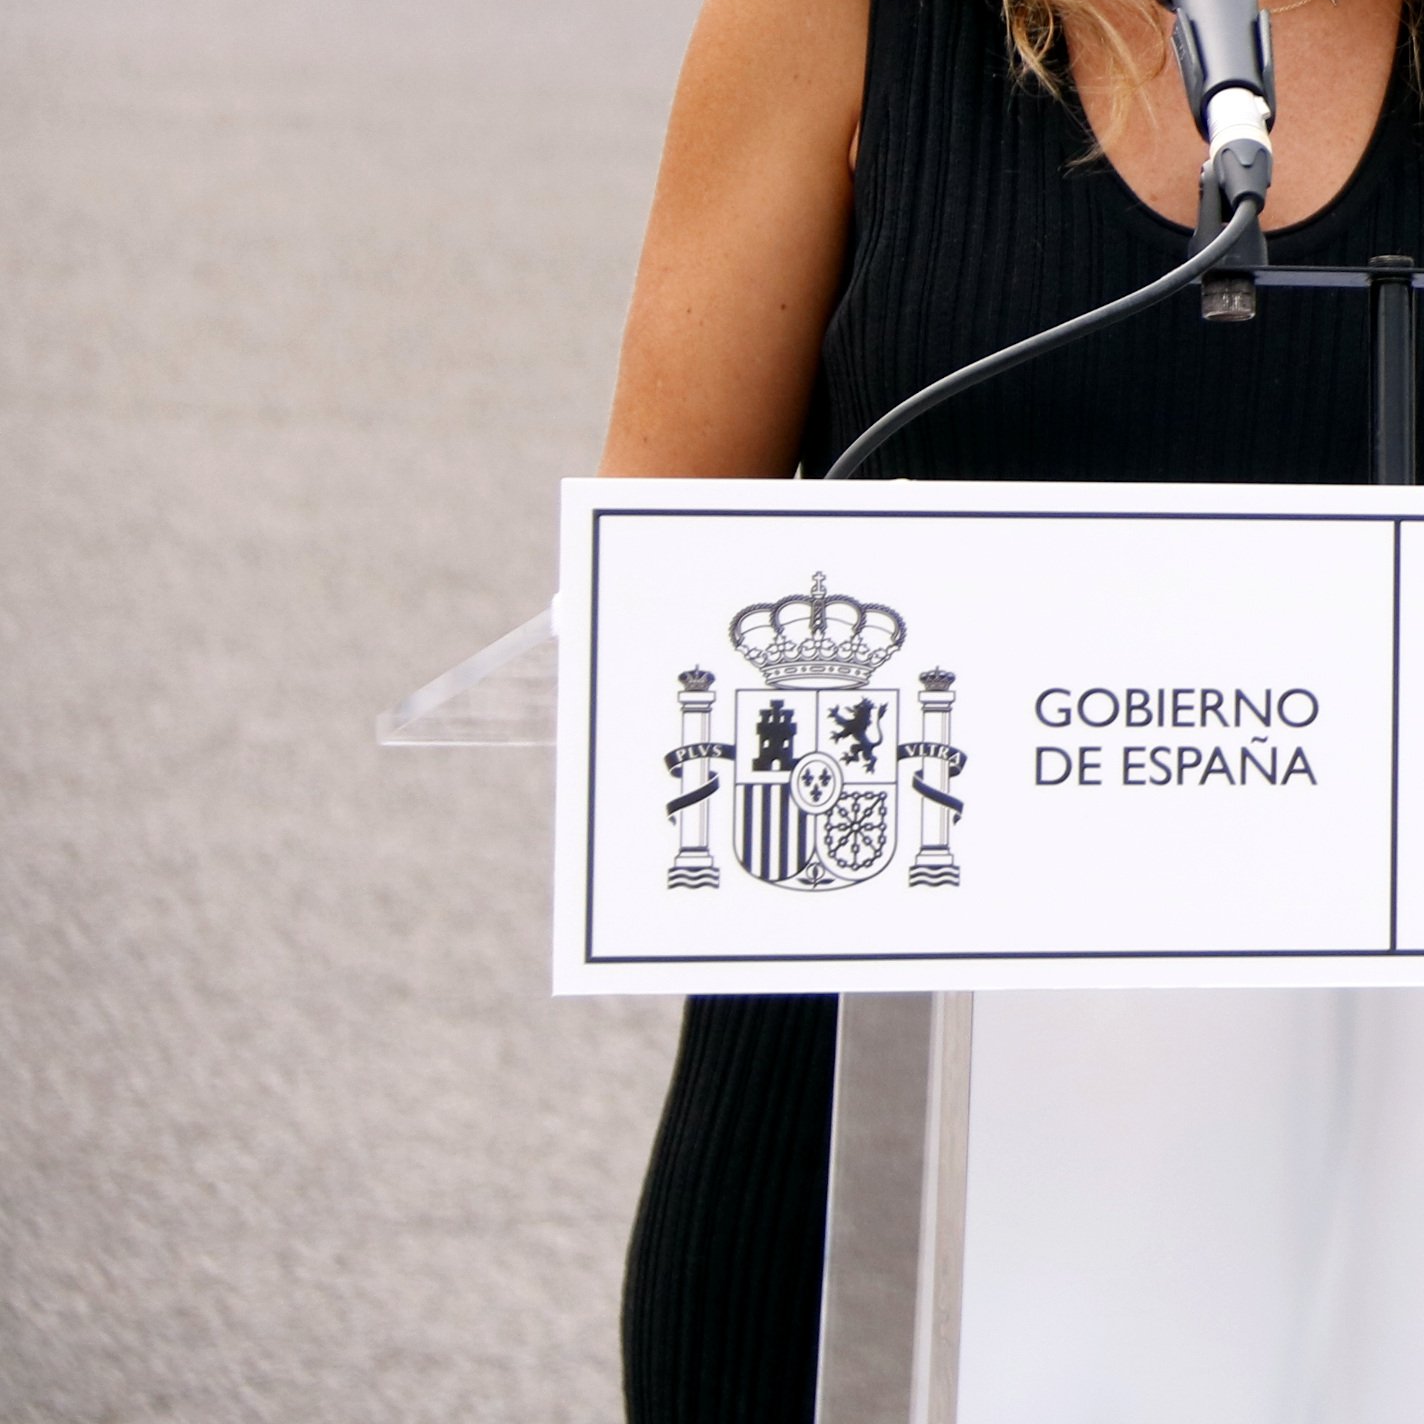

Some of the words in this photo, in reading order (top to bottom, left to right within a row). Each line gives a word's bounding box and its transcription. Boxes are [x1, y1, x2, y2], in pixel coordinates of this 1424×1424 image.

[1035, 687, 1319, 728] GOBIERNO
[675, 744, 722, 763] PLVS
[1035, 746, 1102, 786] DE
[1122, 736, 1317, 786] ESPAÑA
